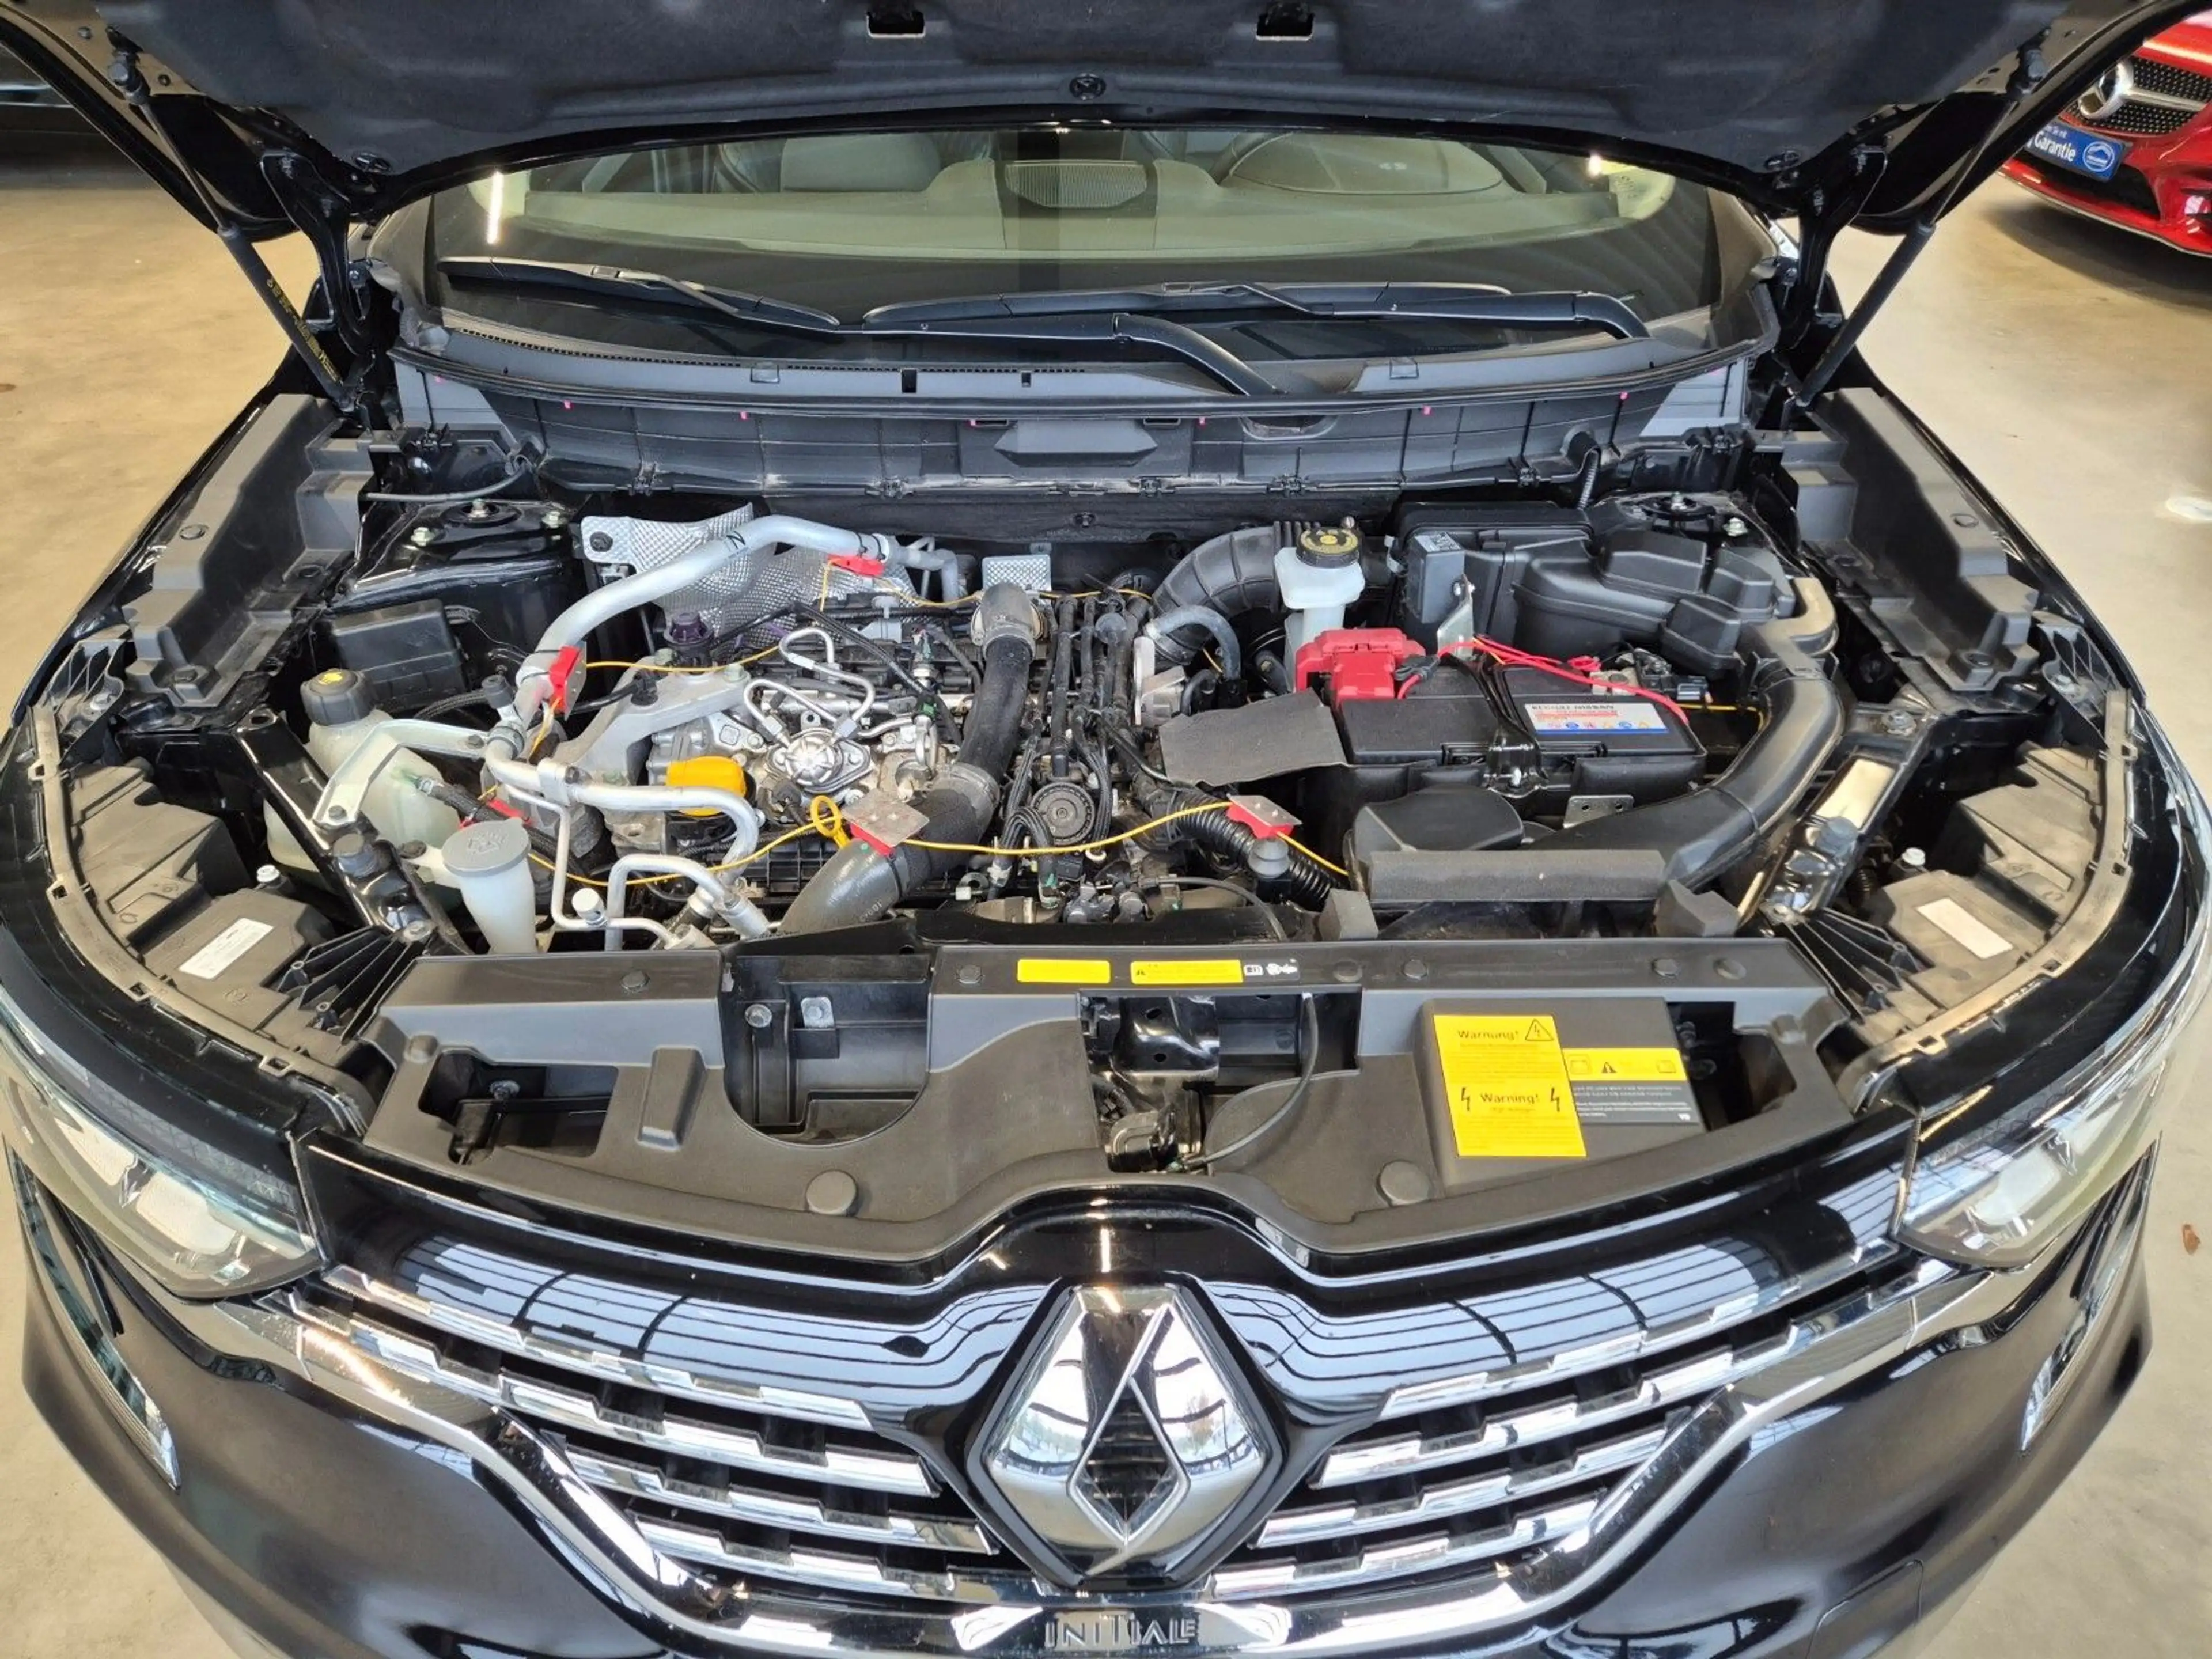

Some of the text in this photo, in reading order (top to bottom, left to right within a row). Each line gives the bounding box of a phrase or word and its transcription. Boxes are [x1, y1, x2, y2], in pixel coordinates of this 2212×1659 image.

[2034, 130, 2076, 162] Garantie
[1480, 1092, 1539, 1104] Warning!
[1044, 1613, 1196, 1648] INITIALE
